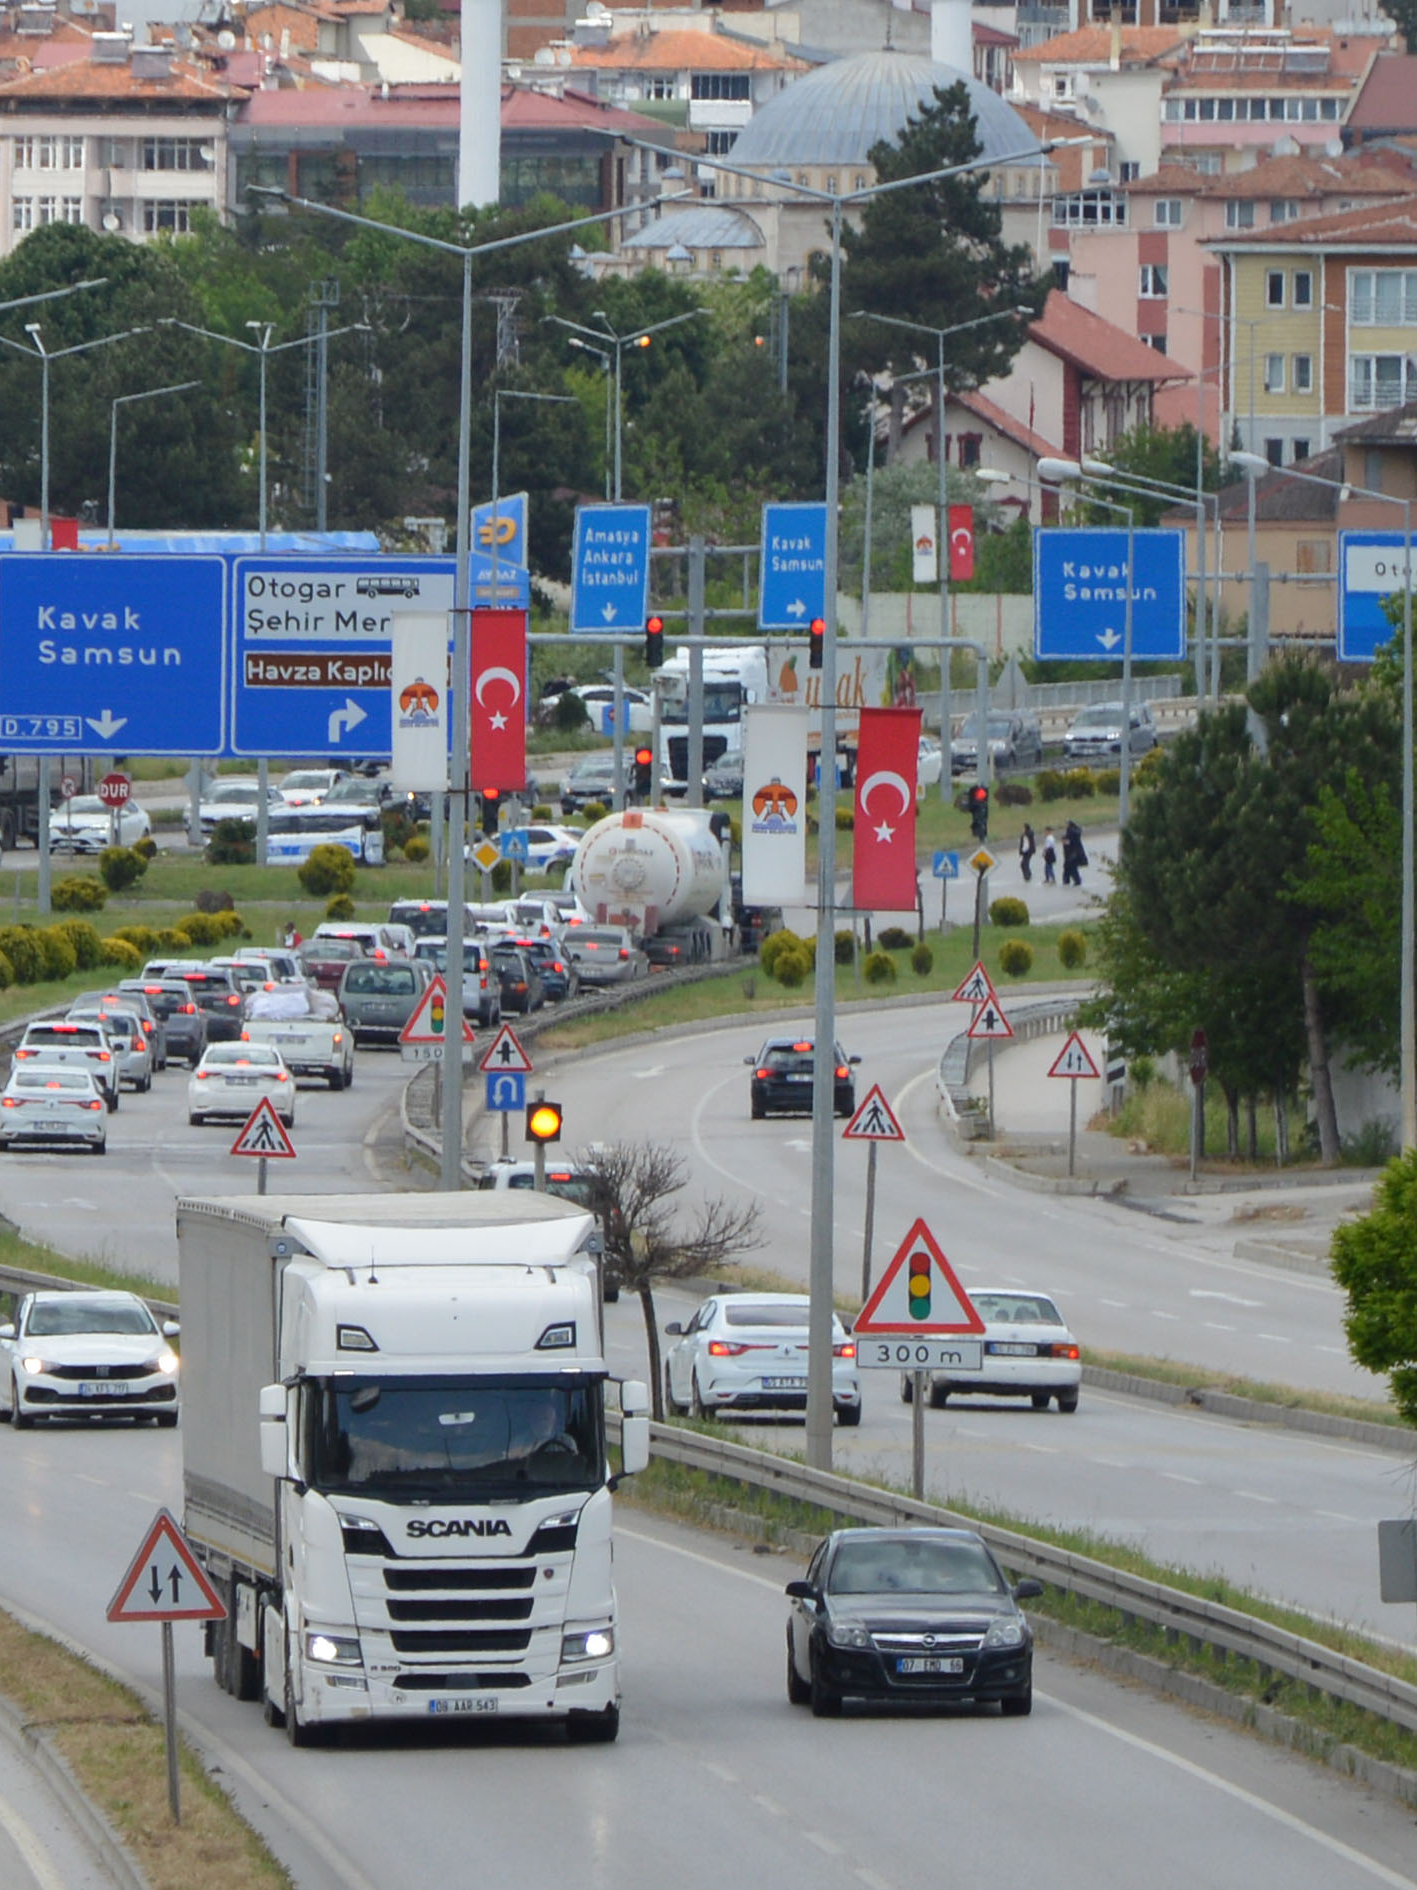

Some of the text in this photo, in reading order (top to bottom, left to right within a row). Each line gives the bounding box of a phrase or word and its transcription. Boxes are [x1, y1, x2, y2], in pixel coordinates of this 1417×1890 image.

[585, 527, 639, 546] Amasya
[772, 535, 812, 551] Kavak
[584, 549, 633, 566] Ankara
[772, 555, 823, 572] Samsun
[248, 576, 346, 603] Otogar
[1064, 583, 1157, 601] Samsun
[38, 606, 141, 630] Kavak
[248, 608, 391, 633] Şehir Mer
[38, 640, 181, 666] Samsun
[247, 660, 321, 681] Havza
[5, 719, 76, 736] D.795
[100, 783, 129, 798] DUR
[413, 1047, 443, 1059] 150
[877, 1344, 962, 1363] 300 m
[406, 1519, 512, 1538] SCANIA
[903, 1659, 915, 1672] 07
[454, 1699, 472, 1711] AAR
[476, 1699, 495, 1712] 543
